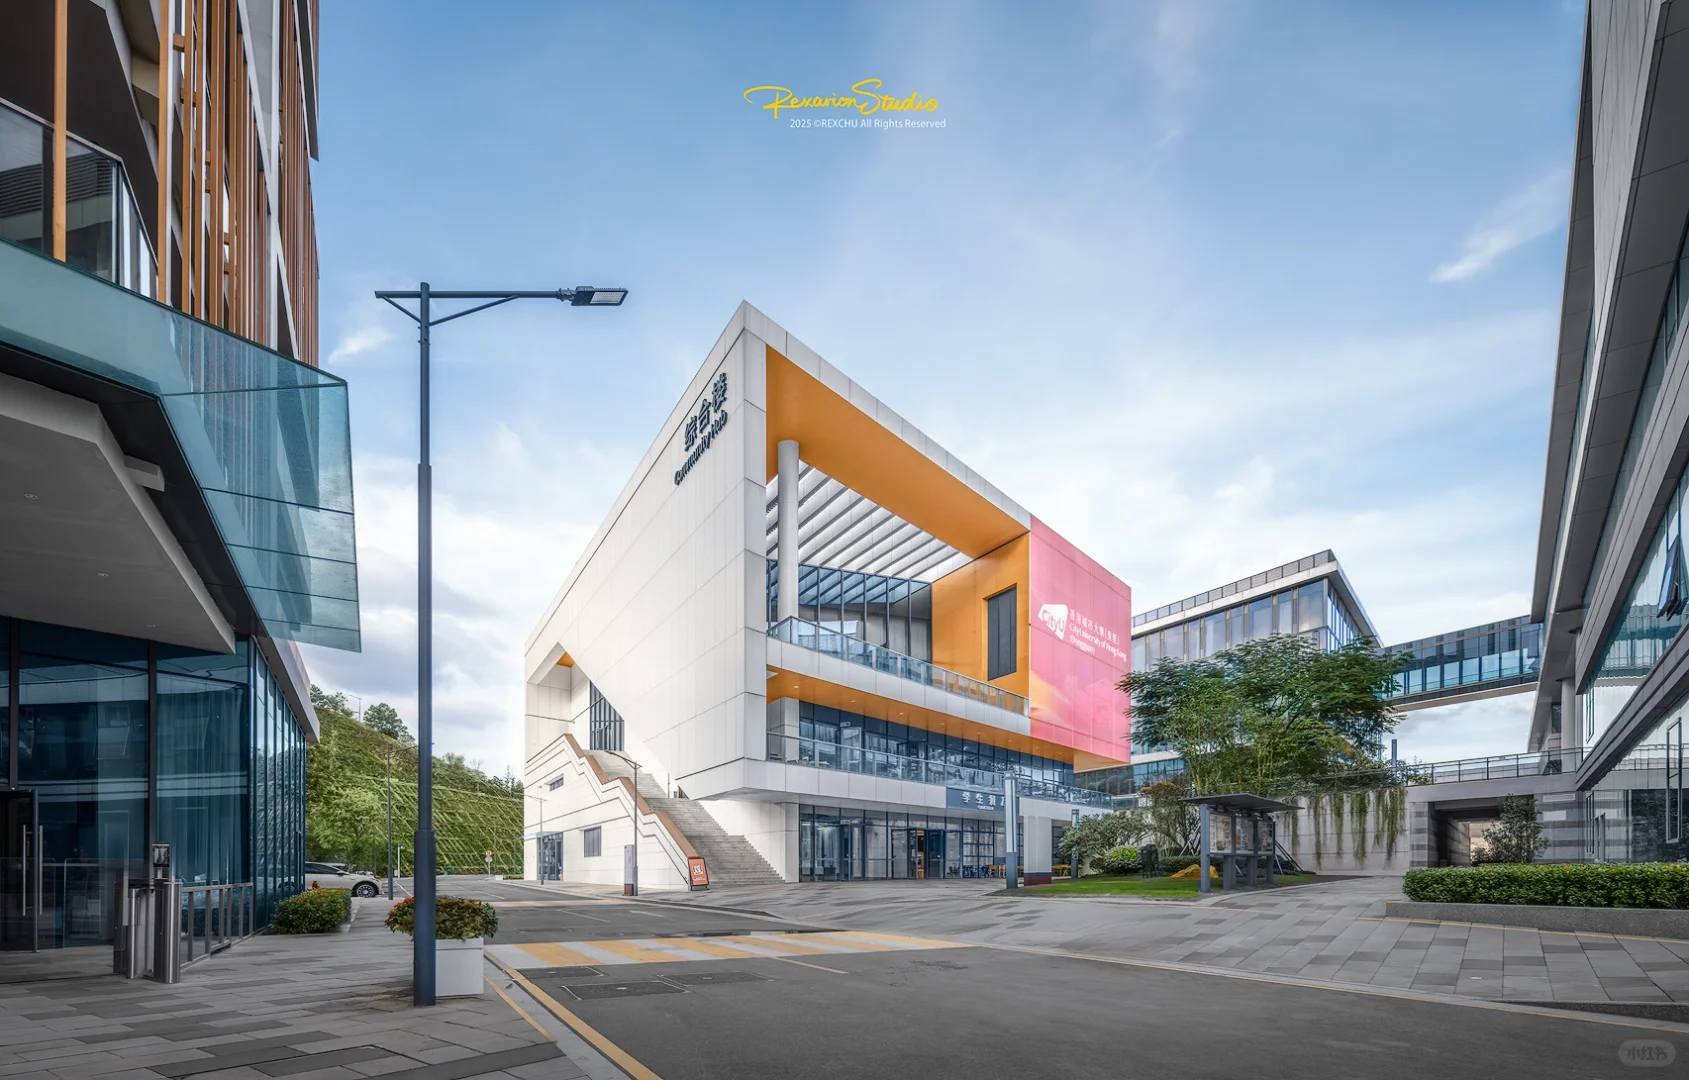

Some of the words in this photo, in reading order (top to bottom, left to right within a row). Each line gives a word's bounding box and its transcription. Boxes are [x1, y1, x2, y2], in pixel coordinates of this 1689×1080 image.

[674, 431, 711, 486] Community
[711, 409, 728, 439] Hub
[1069, 623, 1080, 636] City
[1080, 628, 1101, 648] University
[1101, 640, 1106, 650] of
[1106, 642, 1117, 657] Hong
[1117, 649, 1127, 662] Kong
